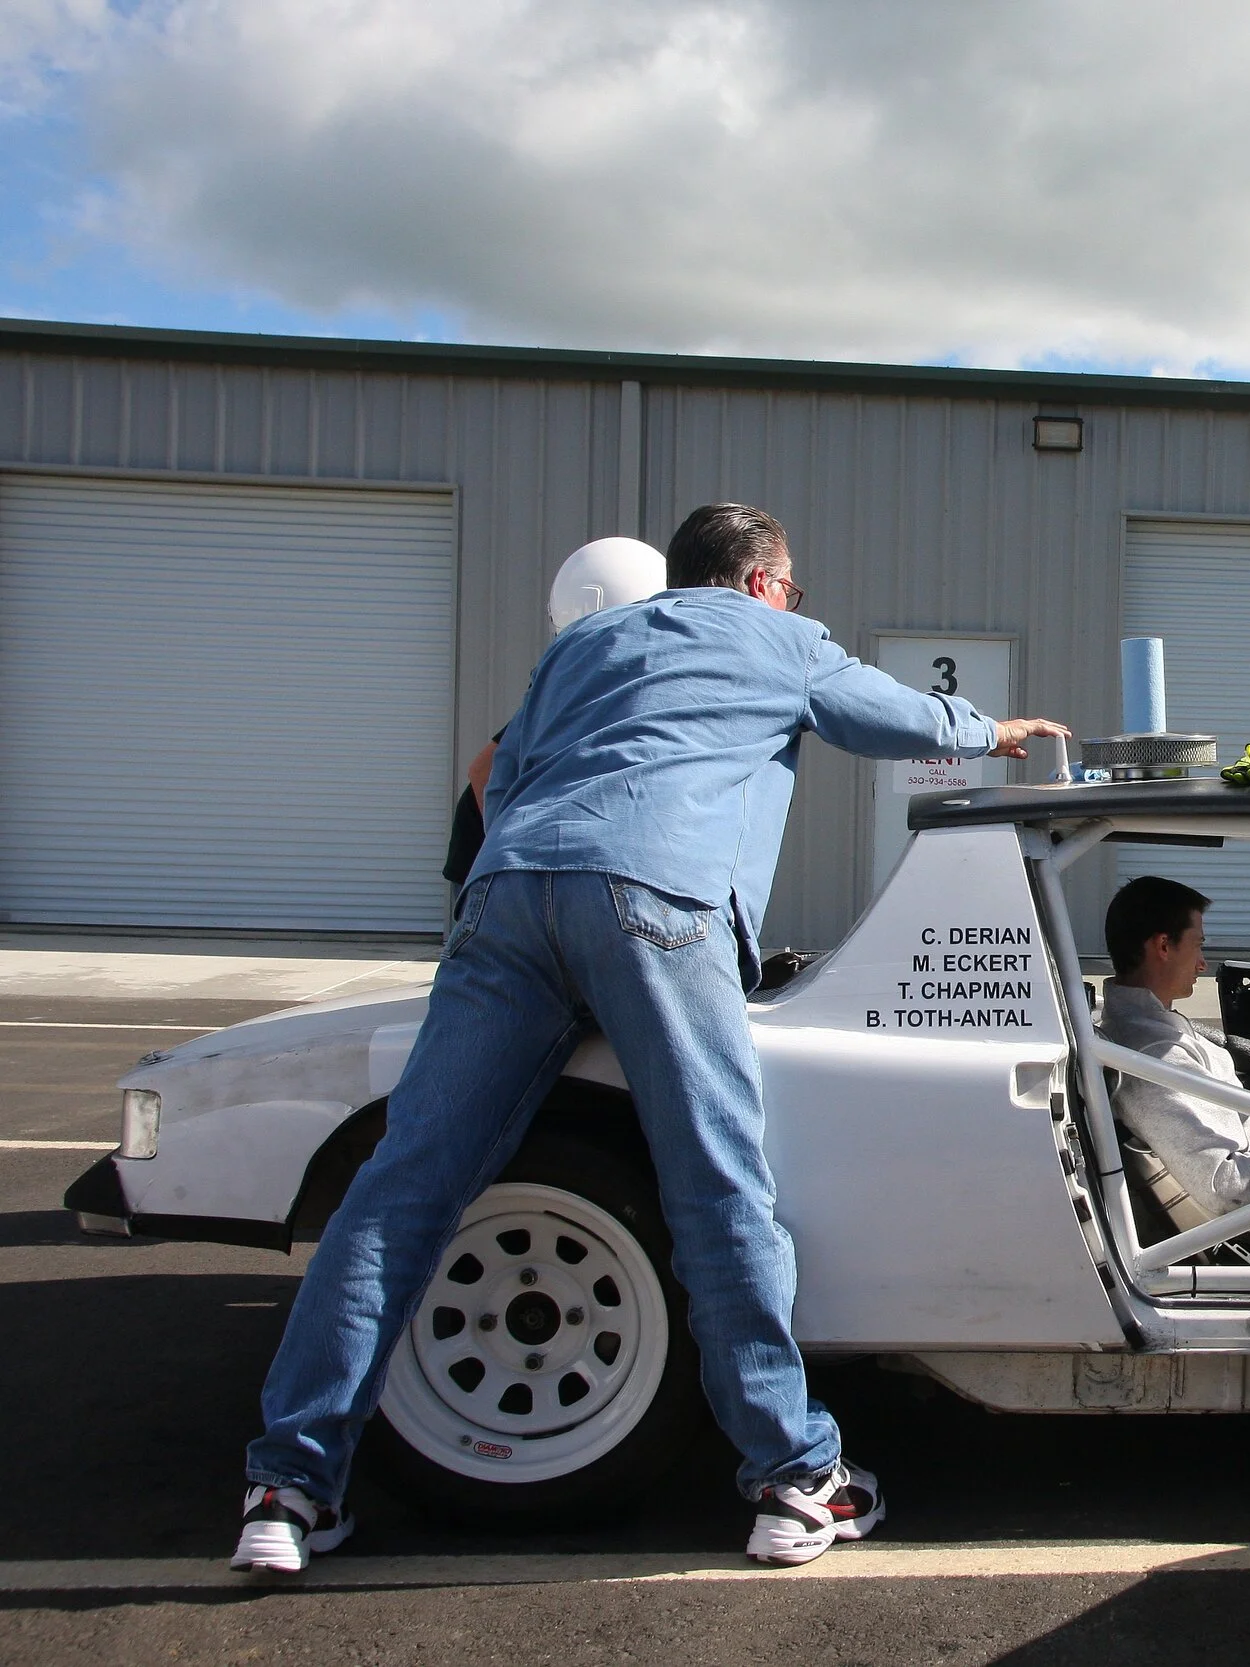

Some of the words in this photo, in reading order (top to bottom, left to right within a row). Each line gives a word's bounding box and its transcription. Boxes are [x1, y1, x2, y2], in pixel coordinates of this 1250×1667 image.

[932, 657, 958, 696] 3
[907, 777, 967, 786] 530-934-5588
[921, 927, 941, 945] C.
[950, 927, 1031, 945] DERIAN
[913, 954, 935, 972] M.
[943, 954, 1031, 972] ECKERT
[898, 982, 913, 999] T.
[921, 981, 1031, 999] CHAPMAN
[866, 1010, 886, 1027] B.
[894, 1009, 1032, 1027] TOTH-ANTAL
